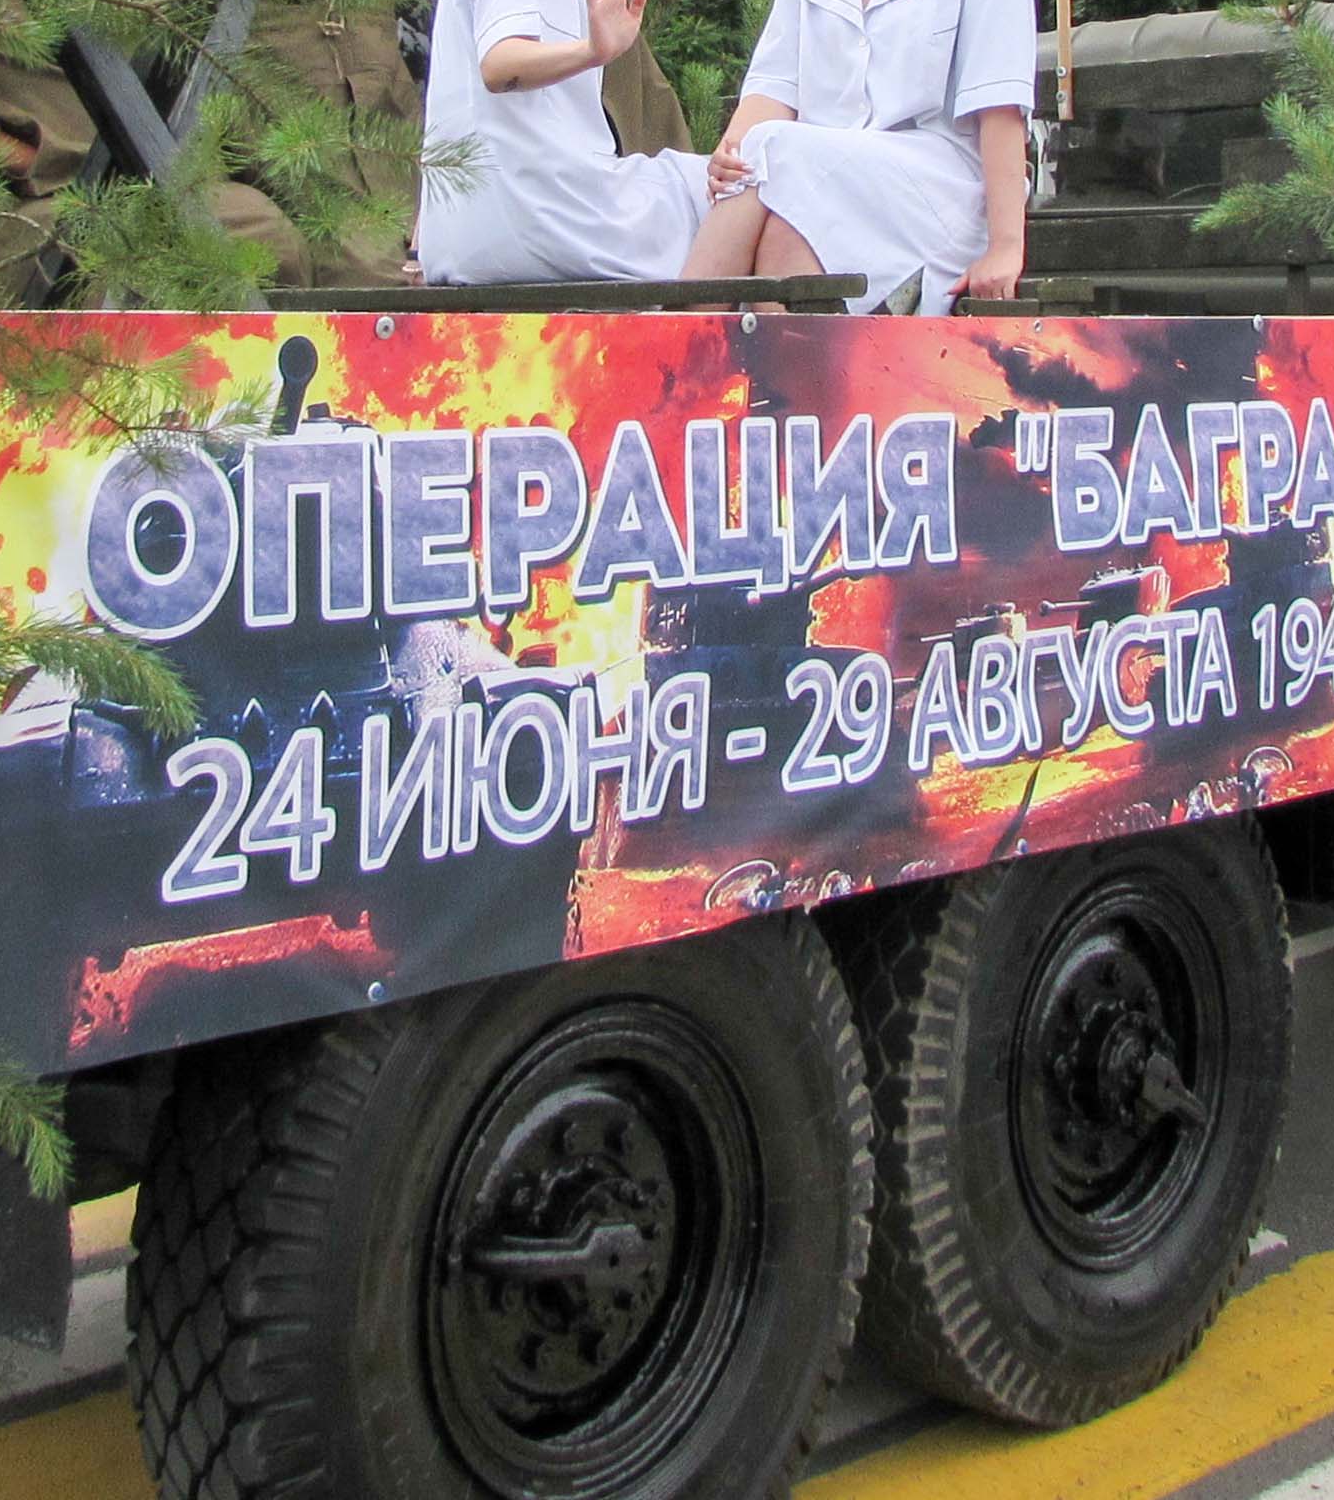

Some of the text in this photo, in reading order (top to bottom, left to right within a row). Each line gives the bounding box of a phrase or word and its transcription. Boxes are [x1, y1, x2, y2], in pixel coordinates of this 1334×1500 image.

[84, 410, 958, 641] ОПЕРАЦИЯ
[161, 725, 335, 904] 24
[359, 671, 710, 873] ИЮНЯ
[725, 725, 767, 762] -
[781, 650, 892, 795] 29
[908, 605, 1238, 773] АВГУСТА
